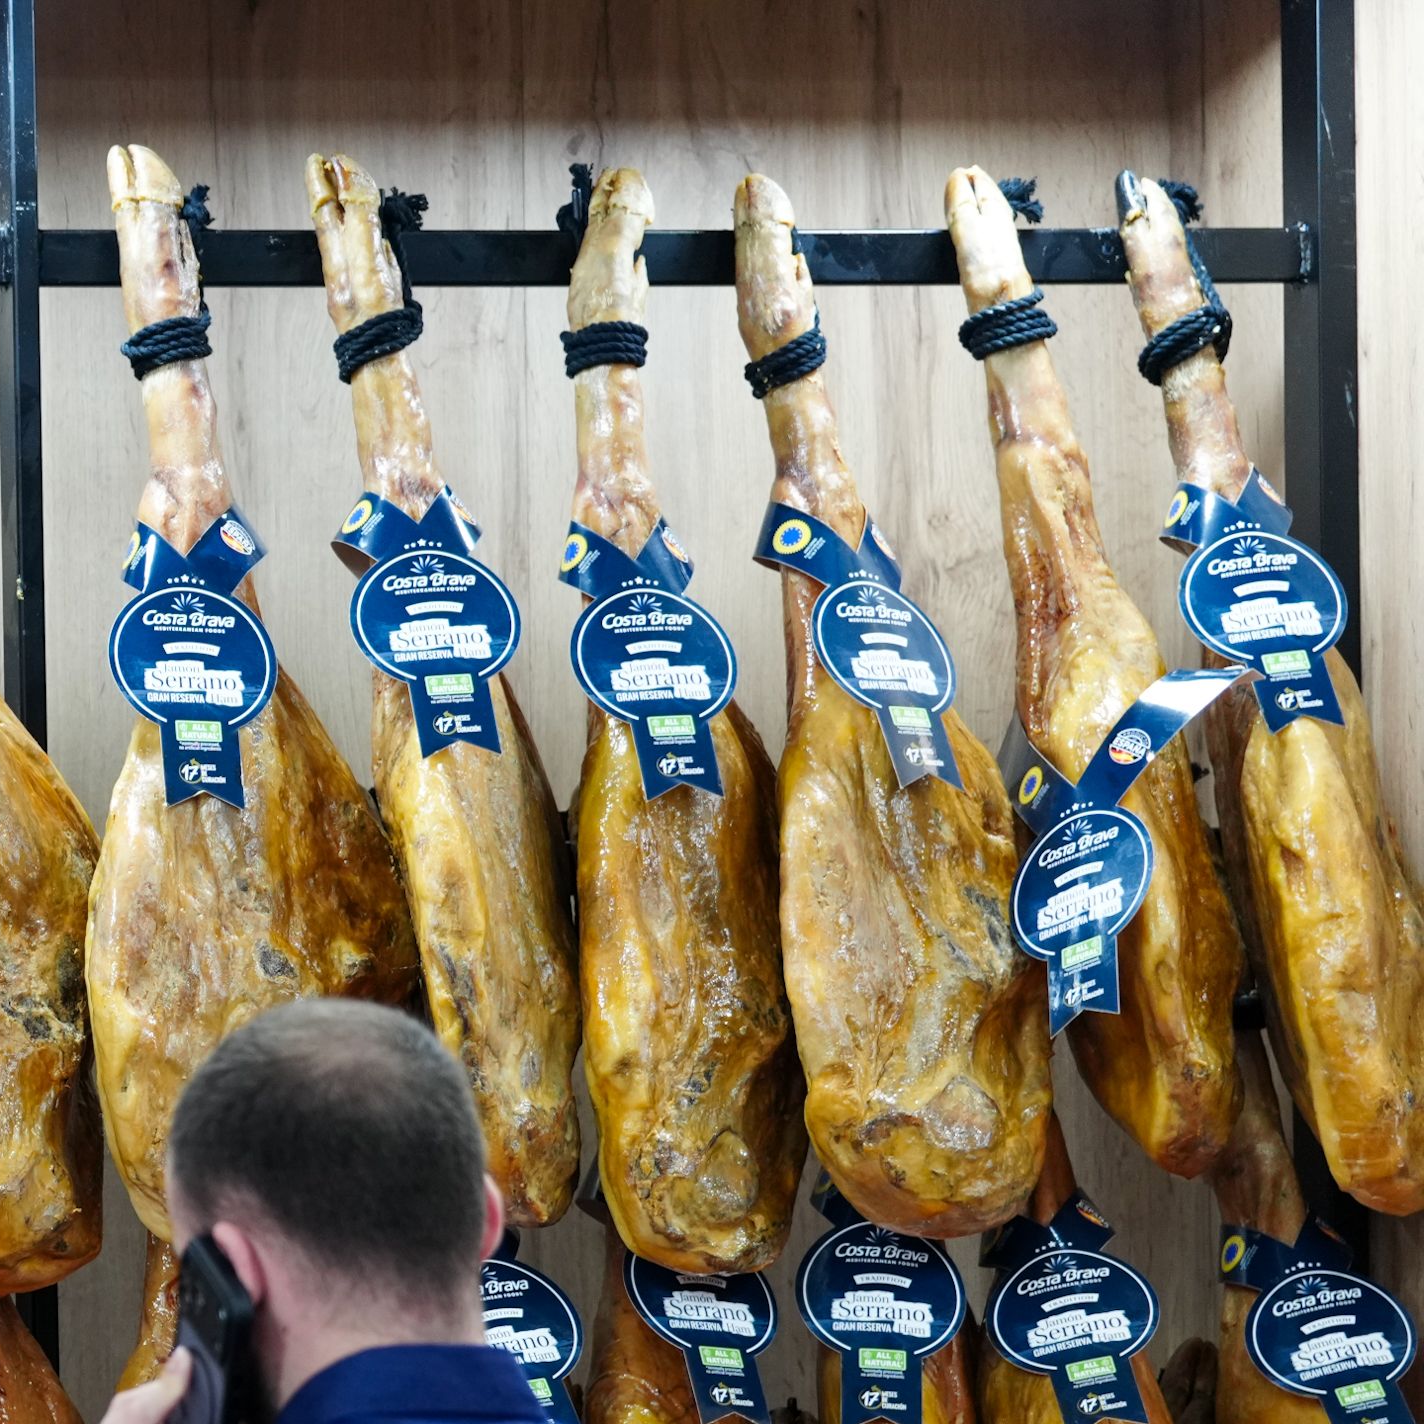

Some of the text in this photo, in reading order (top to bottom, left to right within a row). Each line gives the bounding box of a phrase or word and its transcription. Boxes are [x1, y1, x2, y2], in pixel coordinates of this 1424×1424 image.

[1208, 553, 1300, 573] Costa Brava
[383, 572, 477, 591] Costa Brava
[143, 610, 235, 629] Costa Brava
[602, 611, 694, 629] Costa Brava
[1227, 608, 1315, 631] Serrano
[396, 630, 485, 650] Serrano
[151, 670, 237, 691] Serrano
[616, 670, 704, 689] Serrano
[1038, 826, 1118, 868] Costa Brava
[1043, 885, 1117, 927] Serrano
[836, 1241, 930, 1265] Costa Brava
[898, 1261, 920, 1269] FOODS
[860, 1275, 906, 1286] TRADITION
[1016, 1267, 1111, 1293] Costa Brava
[852, 1293, 890, 1304] Jamón
[1272, 1288, 1364, 1314] Costa Brava
[667, 1298, 749, 1322] Serrano
[839, 1300, 926, 1323] Serrano
[833, 1321, 925, 1335] GRAN RESERVA Ham
[1032, 1315, 1124, 1345] Serrano
[876, 1351, 891, 1360] ALL
[1296, 1338, 1385, 1368] Serrano
[861, 1390, 880, 1407] 17
[881, 1390, 898, 1398] MESES
[881, 1402, 906, 1410] CURACIÓN
